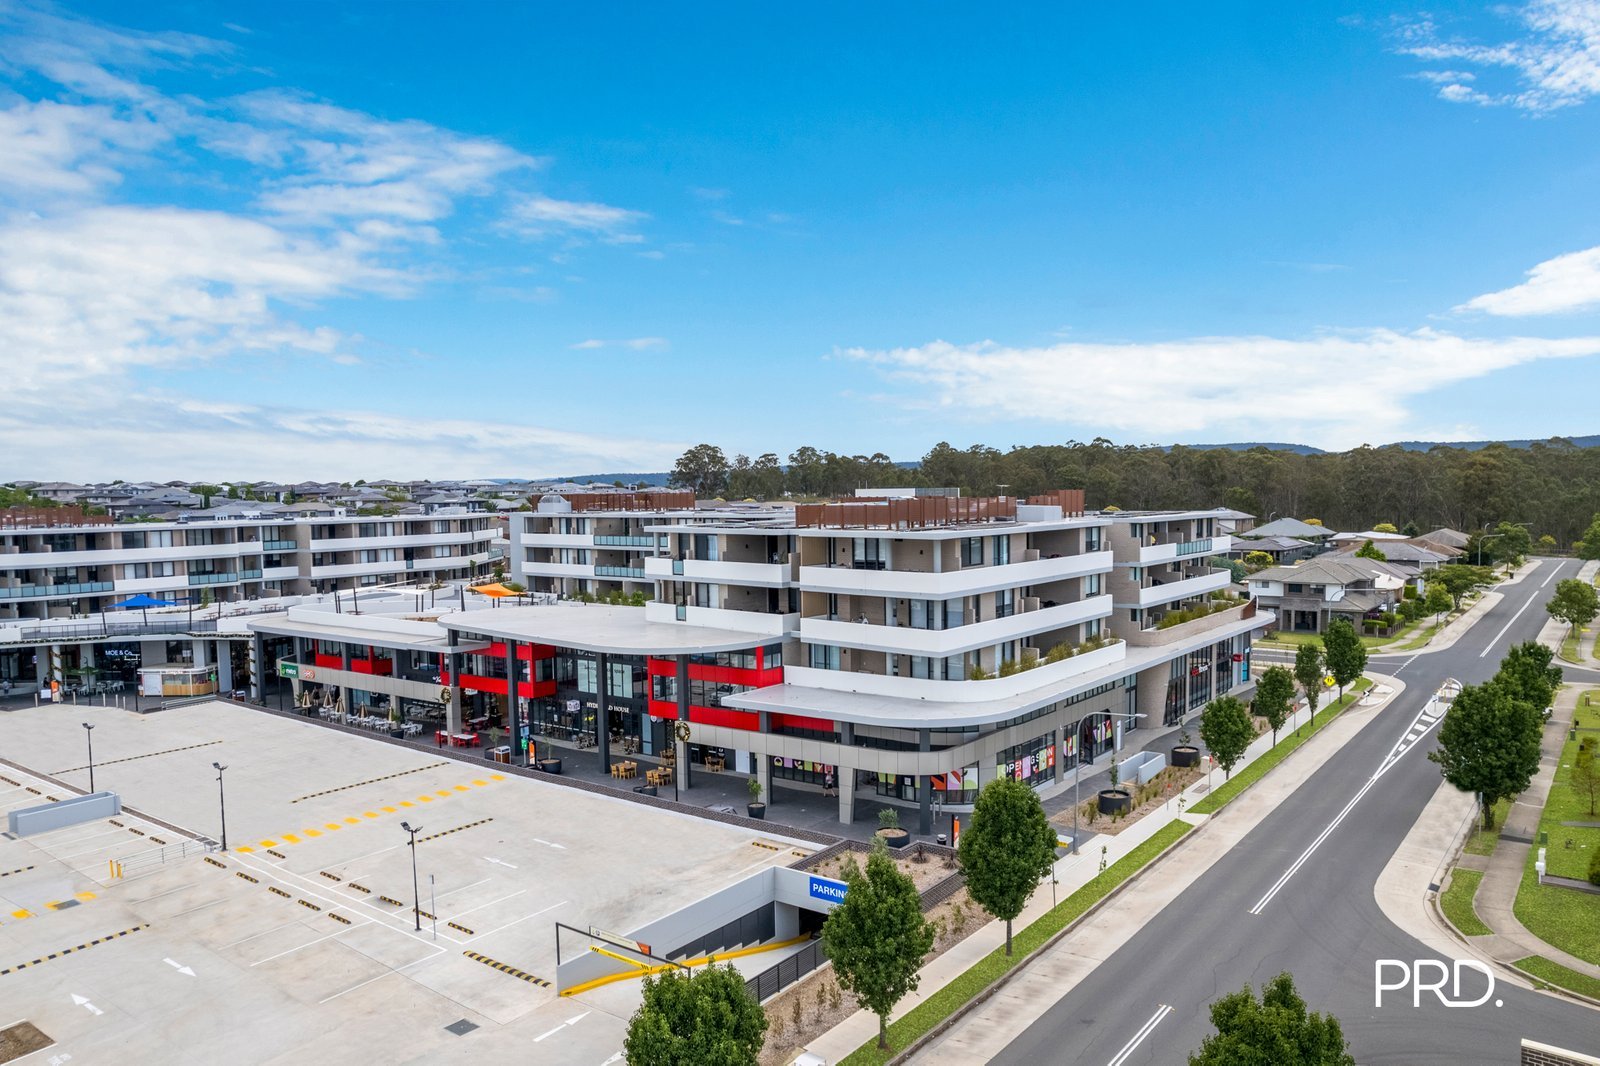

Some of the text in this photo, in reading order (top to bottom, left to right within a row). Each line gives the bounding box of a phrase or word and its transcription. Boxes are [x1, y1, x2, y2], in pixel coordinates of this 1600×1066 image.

[586, 702, 613, 711] HYDED
[613, 705, 630, 713] HOUSE
[1001, 755, 1035, 774] OPEG
